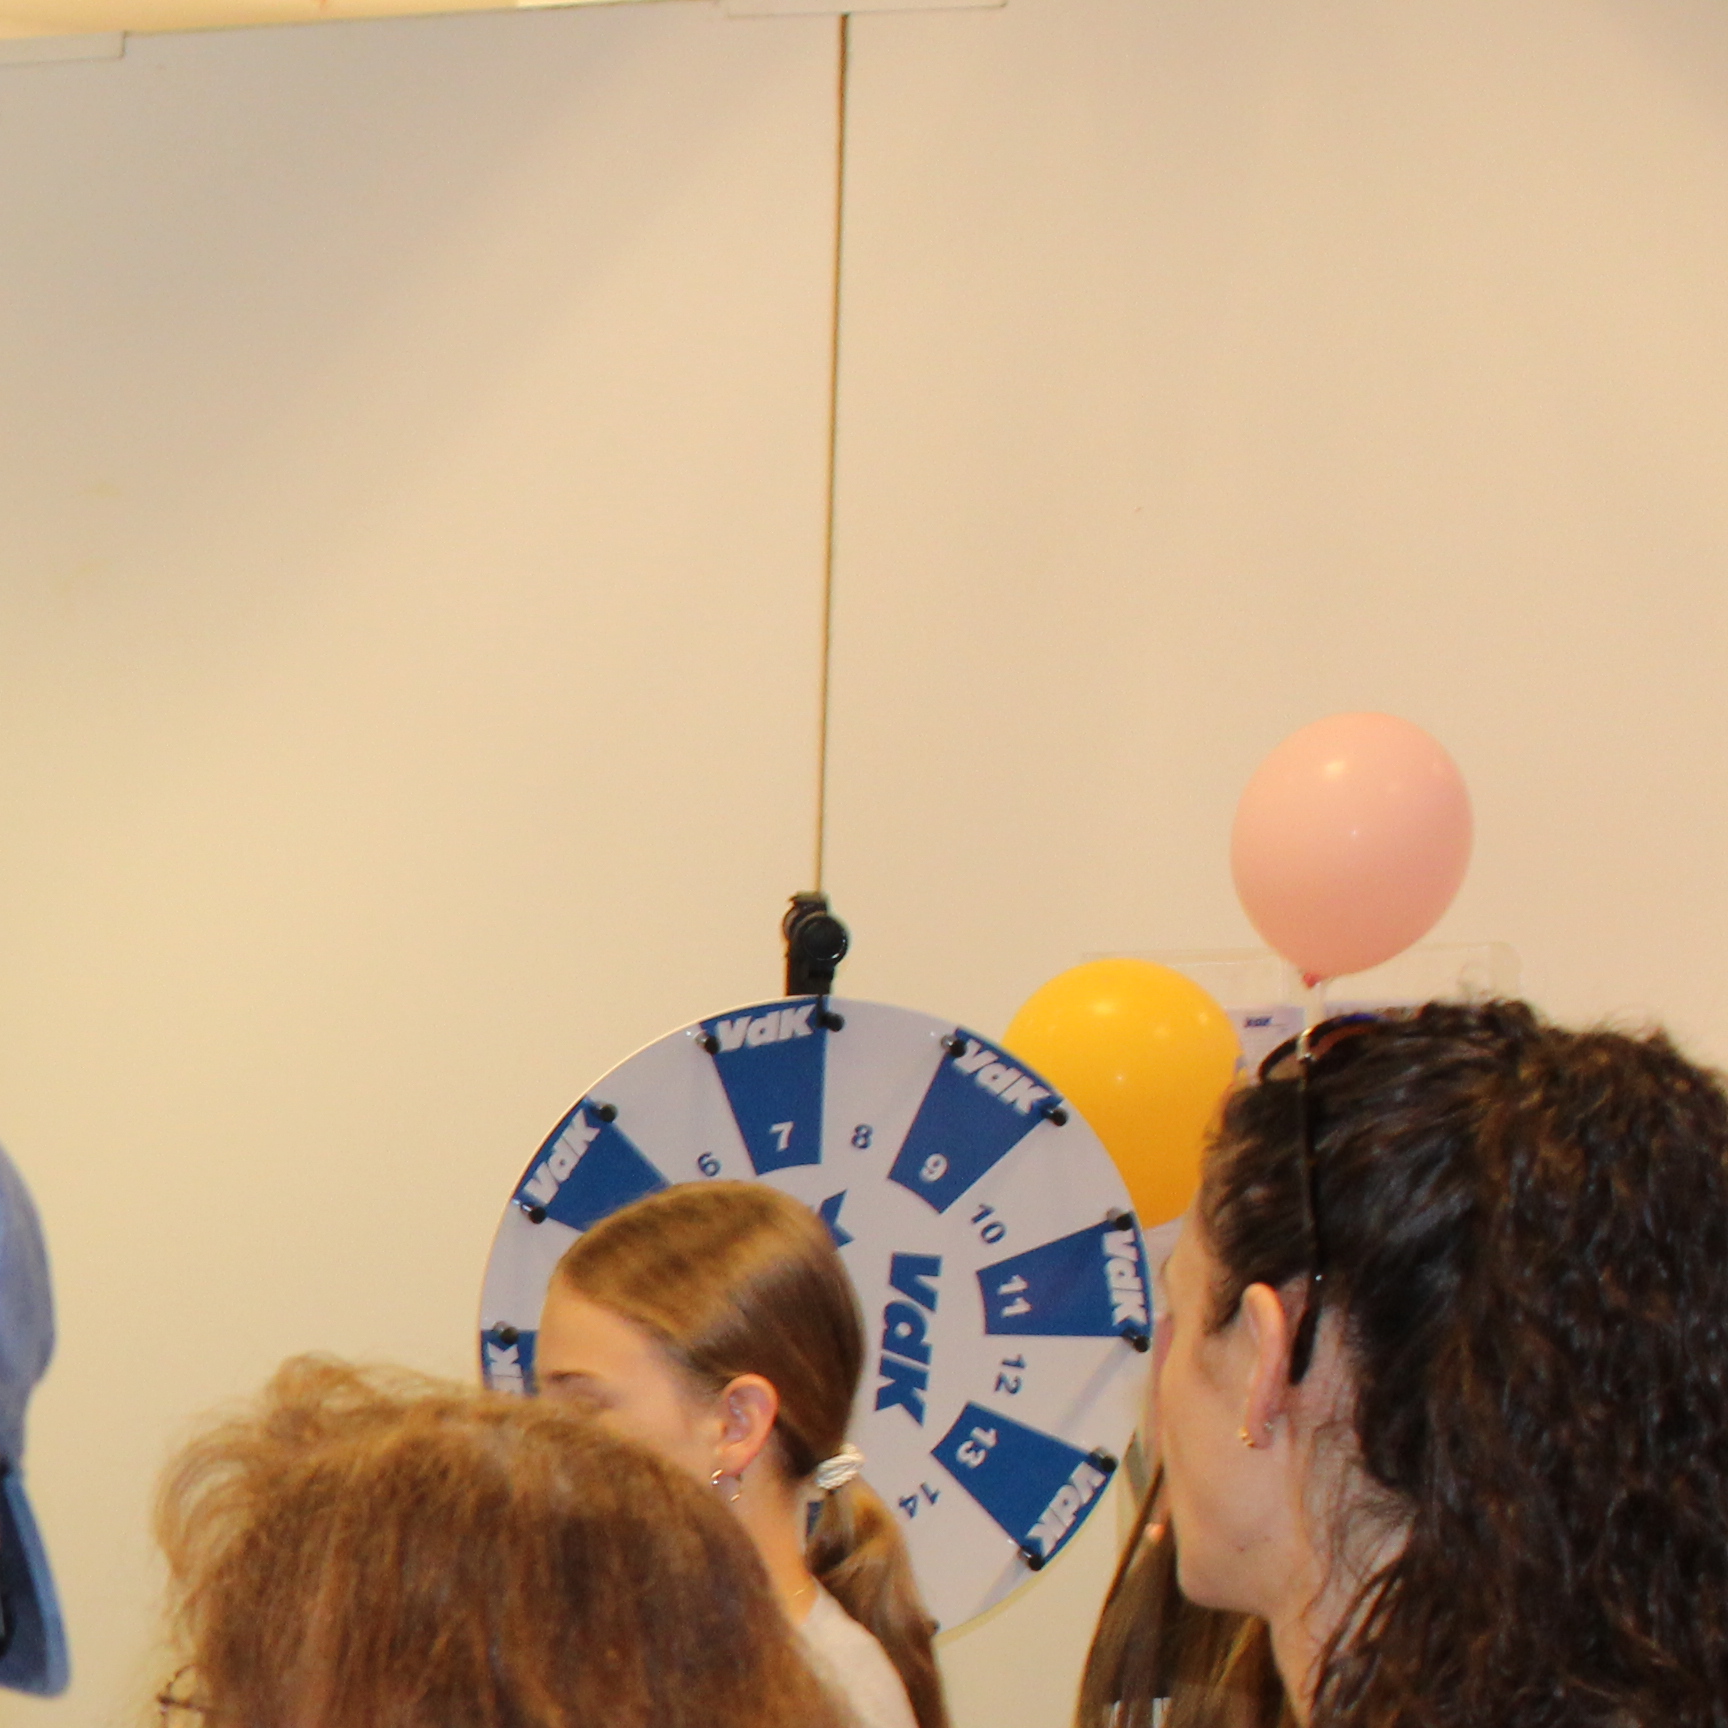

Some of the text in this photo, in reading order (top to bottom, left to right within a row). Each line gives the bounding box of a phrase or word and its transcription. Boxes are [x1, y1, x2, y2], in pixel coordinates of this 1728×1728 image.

[712, 1004, 817, 1054] VdK
[952, 1039, 1050, 1116] VdK
[521, 1107, 602, 1204] VdK
[770, 1120, 794, 1152] 7
[850, 1122, 874, 1150] 8
[696, 1150, 722, 1178] 6
[920, 1152, 948, 1184] 9
[970, 1202, 1007, 1245] 10
[996, 1273, 1031, 1319] 11
[1103, 1229, 1152, 1328] VdK
[874, 1251, 942, 1427] VdK
[994, 1353, 1025, 1396] 12
[955, 1426, 998, 1468] 13
[898, 1481, 941, 1520] 14
[1024, 1462, 1106, 1554] VdK
